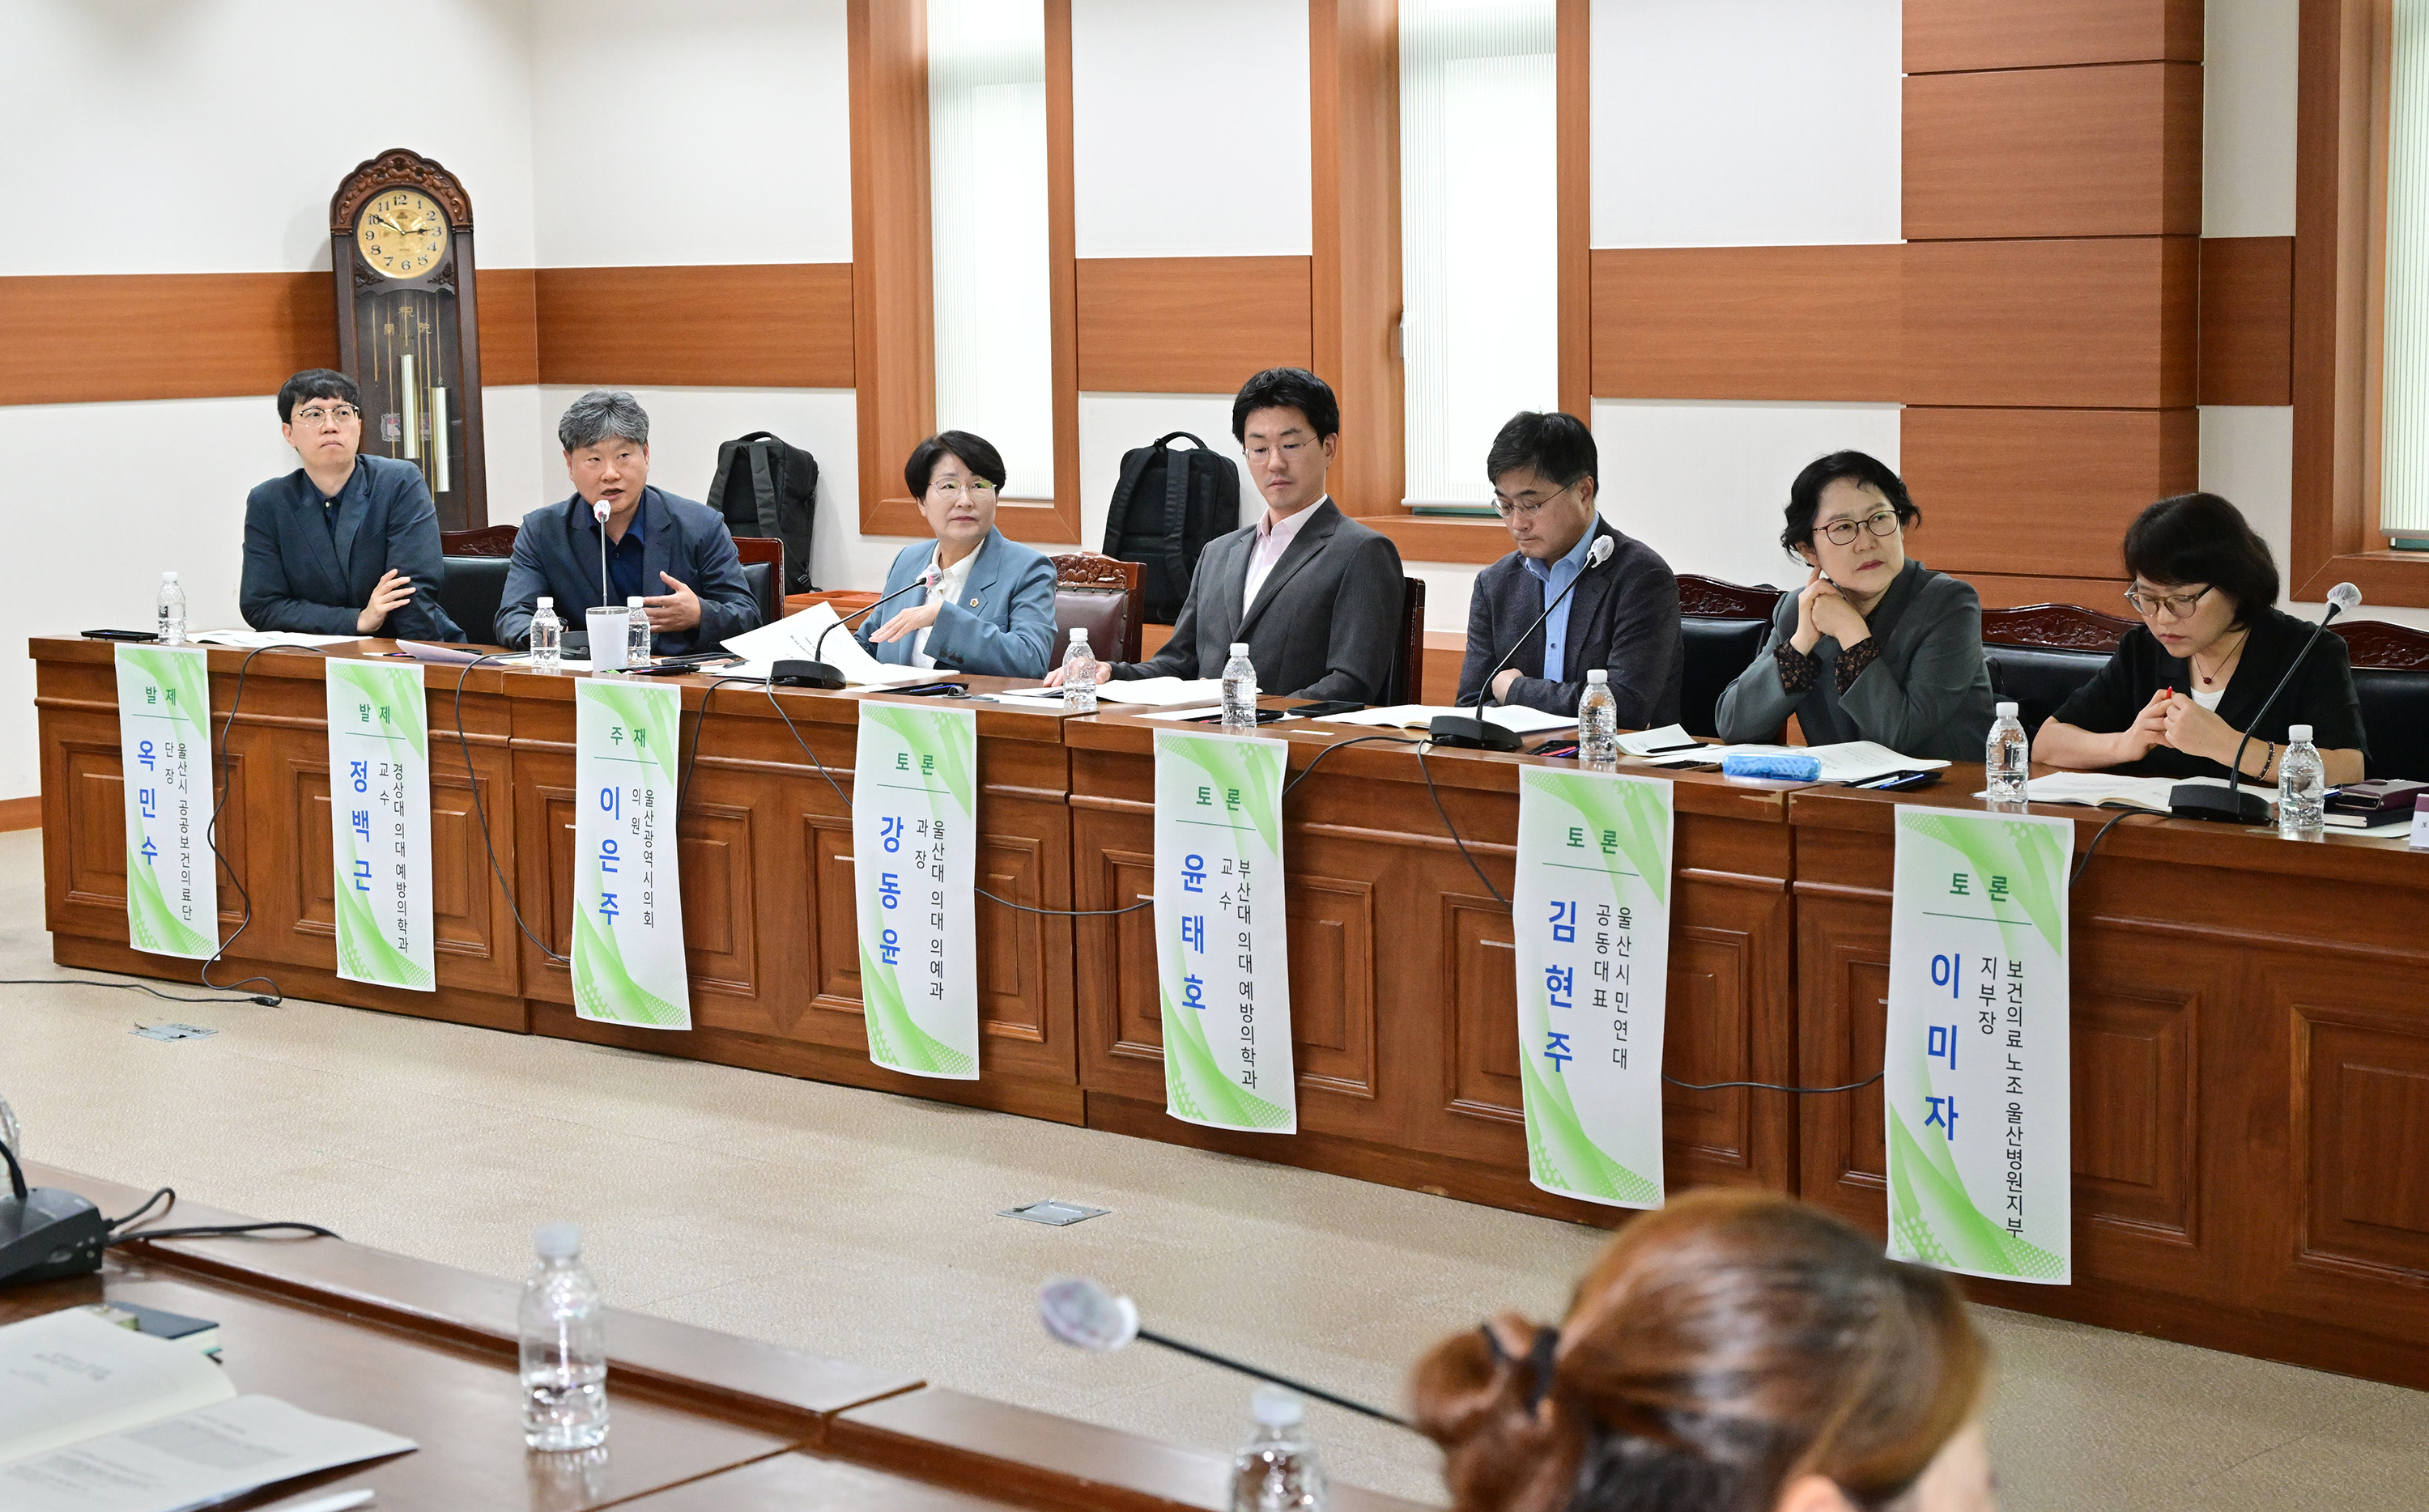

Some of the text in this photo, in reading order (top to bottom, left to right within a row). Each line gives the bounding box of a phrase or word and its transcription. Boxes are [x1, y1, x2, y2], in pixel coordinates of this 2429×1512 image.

[365, 230, 375, 240] 9
[371, 244, 381, 255] 8
[378, 202, 389, 211] 11
[384, 256, 393, 266] 7
[393, 194, 407, 206] 12
[417, 199, 422, 209] 1
[418, 254, 428, 265] 5
[427, 210, 436, 221] 2
[427, 241, 437, 252] 4
[432, 226, 442, 236] 3
[402, 260, 411, 270] 6
[137, 740, 159, 866] 옥민수
[177, 742, 193, 921] 울산시 공공보건의료단
[350, 760, 372, 892] 정백근
[393, 763, 409, 953] 경상대 의대 예방의학과
[598, 786, 621, 926] 이은주
[643, 789, 654, 928] 울산광역시의회
[878, 816, 904, 966] 강동윤
[929, 820, 946, 1000] 울산대 의대 의예과
[1180, 853, 1207, 1010] 윤태호
[1236, 859, 1258, 1089] 부산대 의대 예방의학과
[1544, 900, 1577, 1072] 김현주
[1592, 903, 1611, 1009] 공동대표
[1612, 907, 1633, 1070] 울산시민연대
[1978, 956, 1997, 1035] 지부장
[1925, 953, 1961, 1141] 이미자
[2006, 1102, 2024, 1239] 울산병원지부
